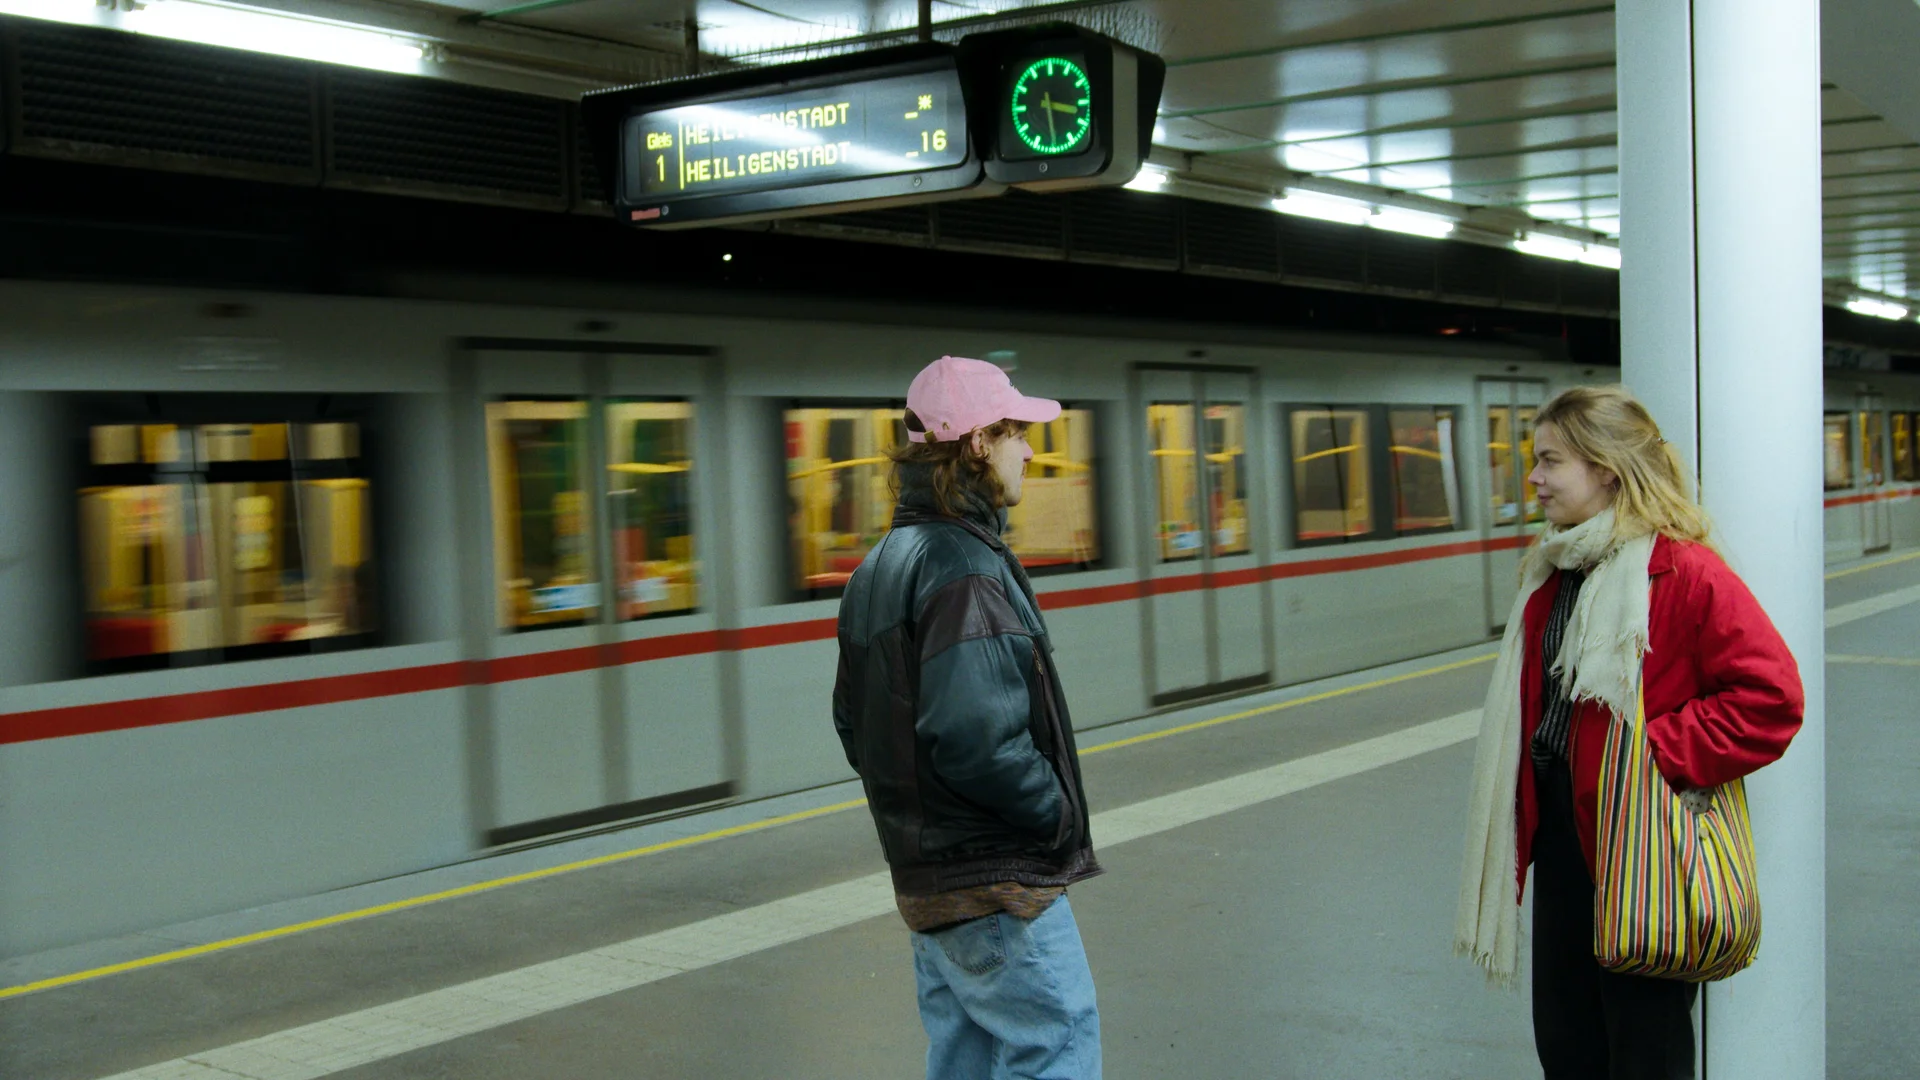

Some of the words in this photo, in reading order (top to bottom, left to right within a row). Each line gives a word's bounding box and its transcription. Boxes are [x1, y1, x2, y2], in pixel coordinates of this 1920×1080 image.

[686, 103, 850, 146] HEILIENSTADT
[656, 154, 665, 182] 1
[686, 141, 851, 183] HEILIGENSTADT
